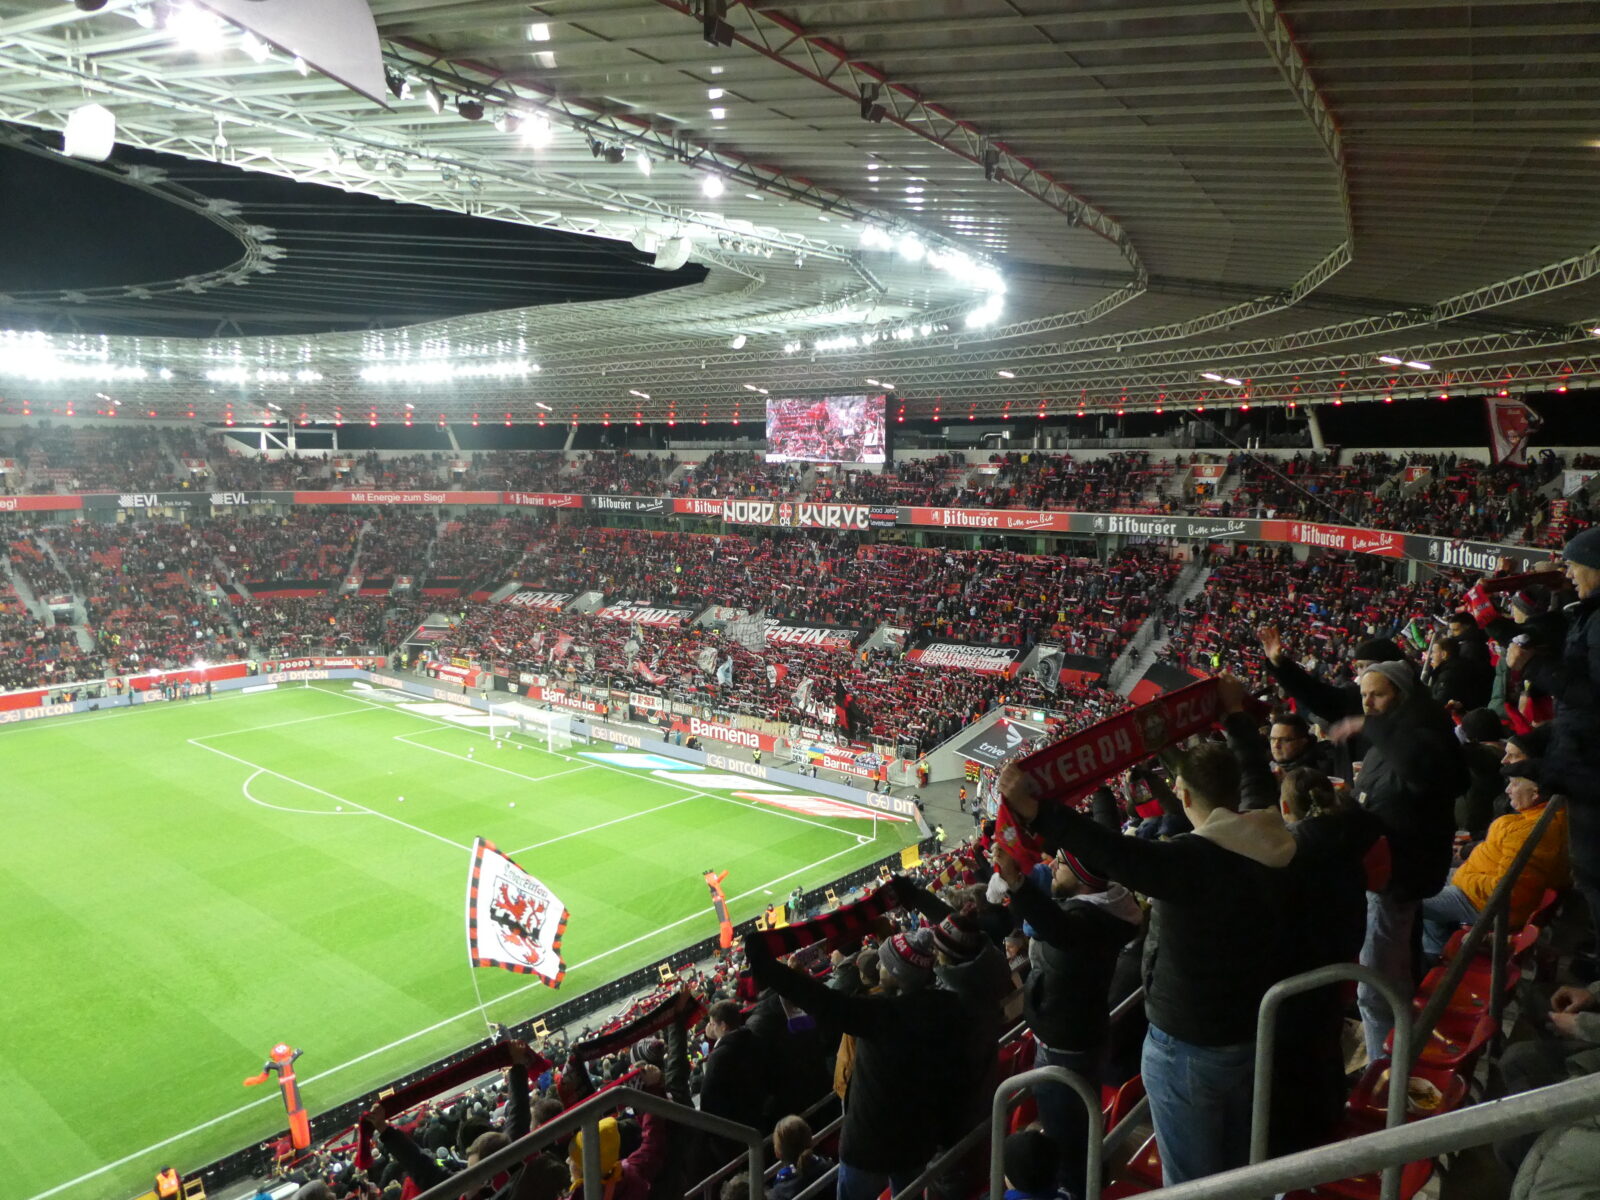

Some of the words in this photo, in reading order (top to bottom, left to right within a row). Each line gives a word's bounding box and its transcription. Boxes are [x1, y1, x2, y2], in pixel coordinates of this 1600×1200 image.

[223, 493, 249, 504] EVL
[351, 493, 365, 502] Mit
[367, 493, 401, 503] Energie
[423, 493, 446, 503] Sieg!
[598, 497, 632, 510] Bitburger
[723, 500, 774, 523] NORD
[780, 516, 791, 527] 04
[799, 503, 869, 529] KURVE
[943, 509, 999, 527] Bitburger
[1108, 516, 1177, 535] Bitburger
[1301, 524, 1346, 548] Bitburger
[1442, 541, 1497, 571] Bitburg
[763, 624, 831, 644] EREIN
[929, 643, 1008, 657] LEIDENSCHAFT
[24, 704, 74, 719] DITCON
[609, 730, 641, 748] DITCON
[690, 717, 759, 748] Barmenia
[980, 742, 1006, 756] trive
[728, 759, 767, 778] DITCON
[894, 799, 914, 814] DIT
